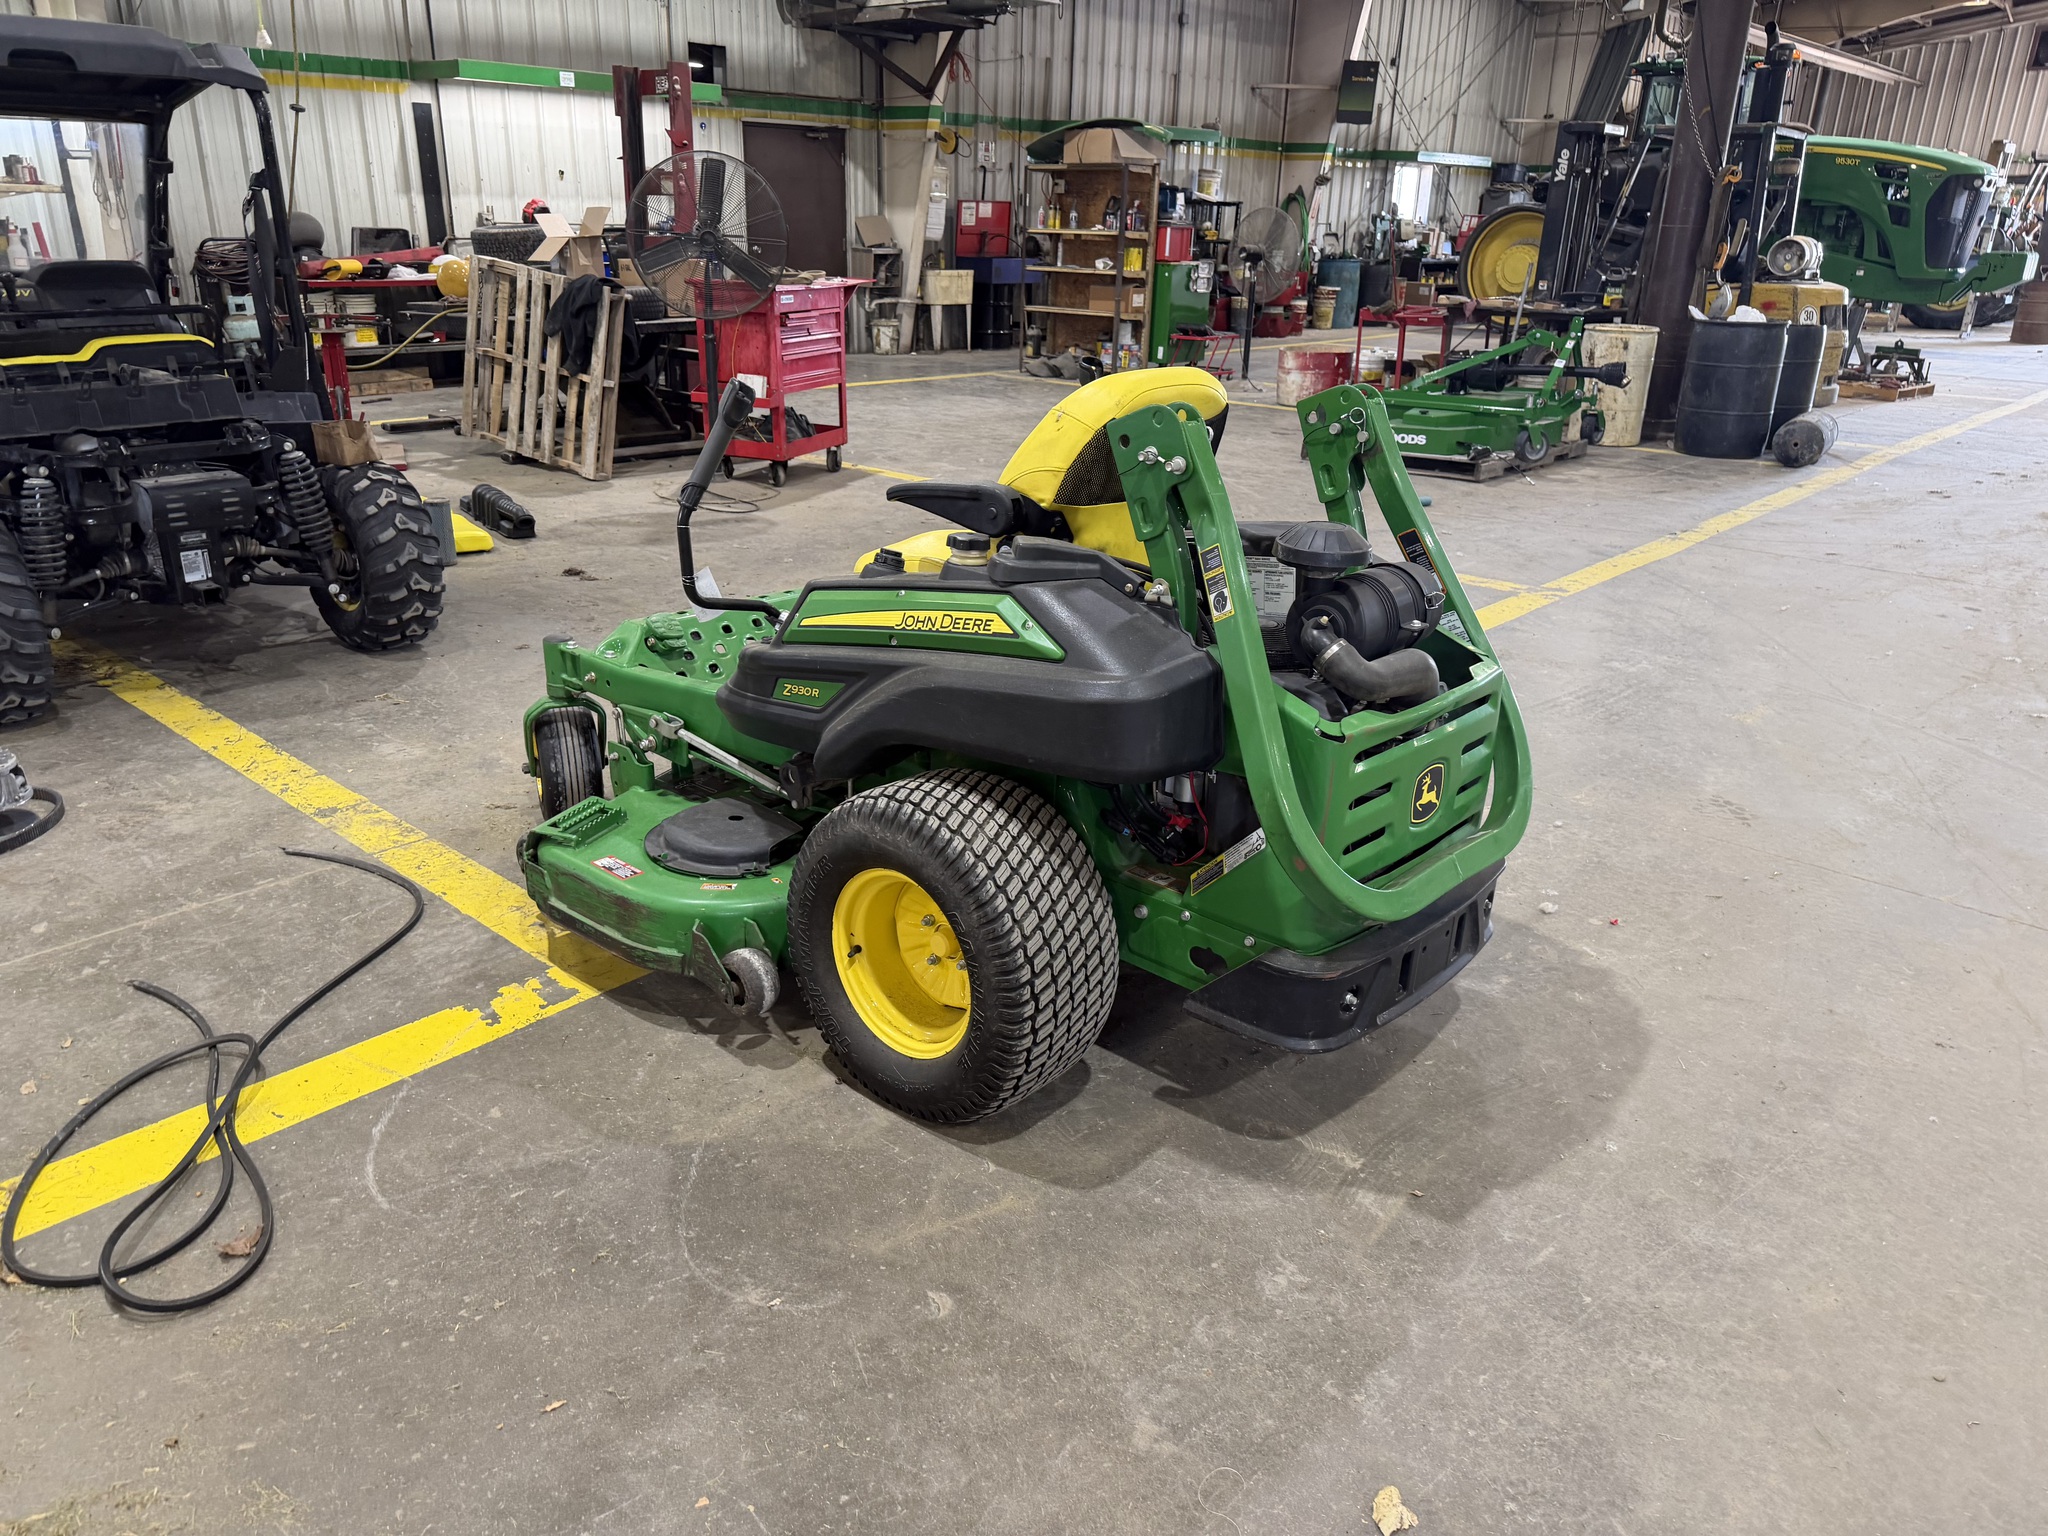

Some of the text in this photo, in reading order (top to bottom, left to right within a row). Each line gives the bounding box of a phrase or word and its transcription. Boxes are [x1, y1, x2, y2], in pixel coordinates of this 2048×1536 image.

[1554, 148, 1570, 182] Yale
[1803, 310, 1814, 321] 30
[1394, 433, 1427, 445] ODS
[895, 612, 995, 632] JOHN DEERE
[783, 683, 820, 698] Z930R
[796, 853, 852, 1053] TURF MASTER
[946, 911, 985, 1077] CARLISLE
